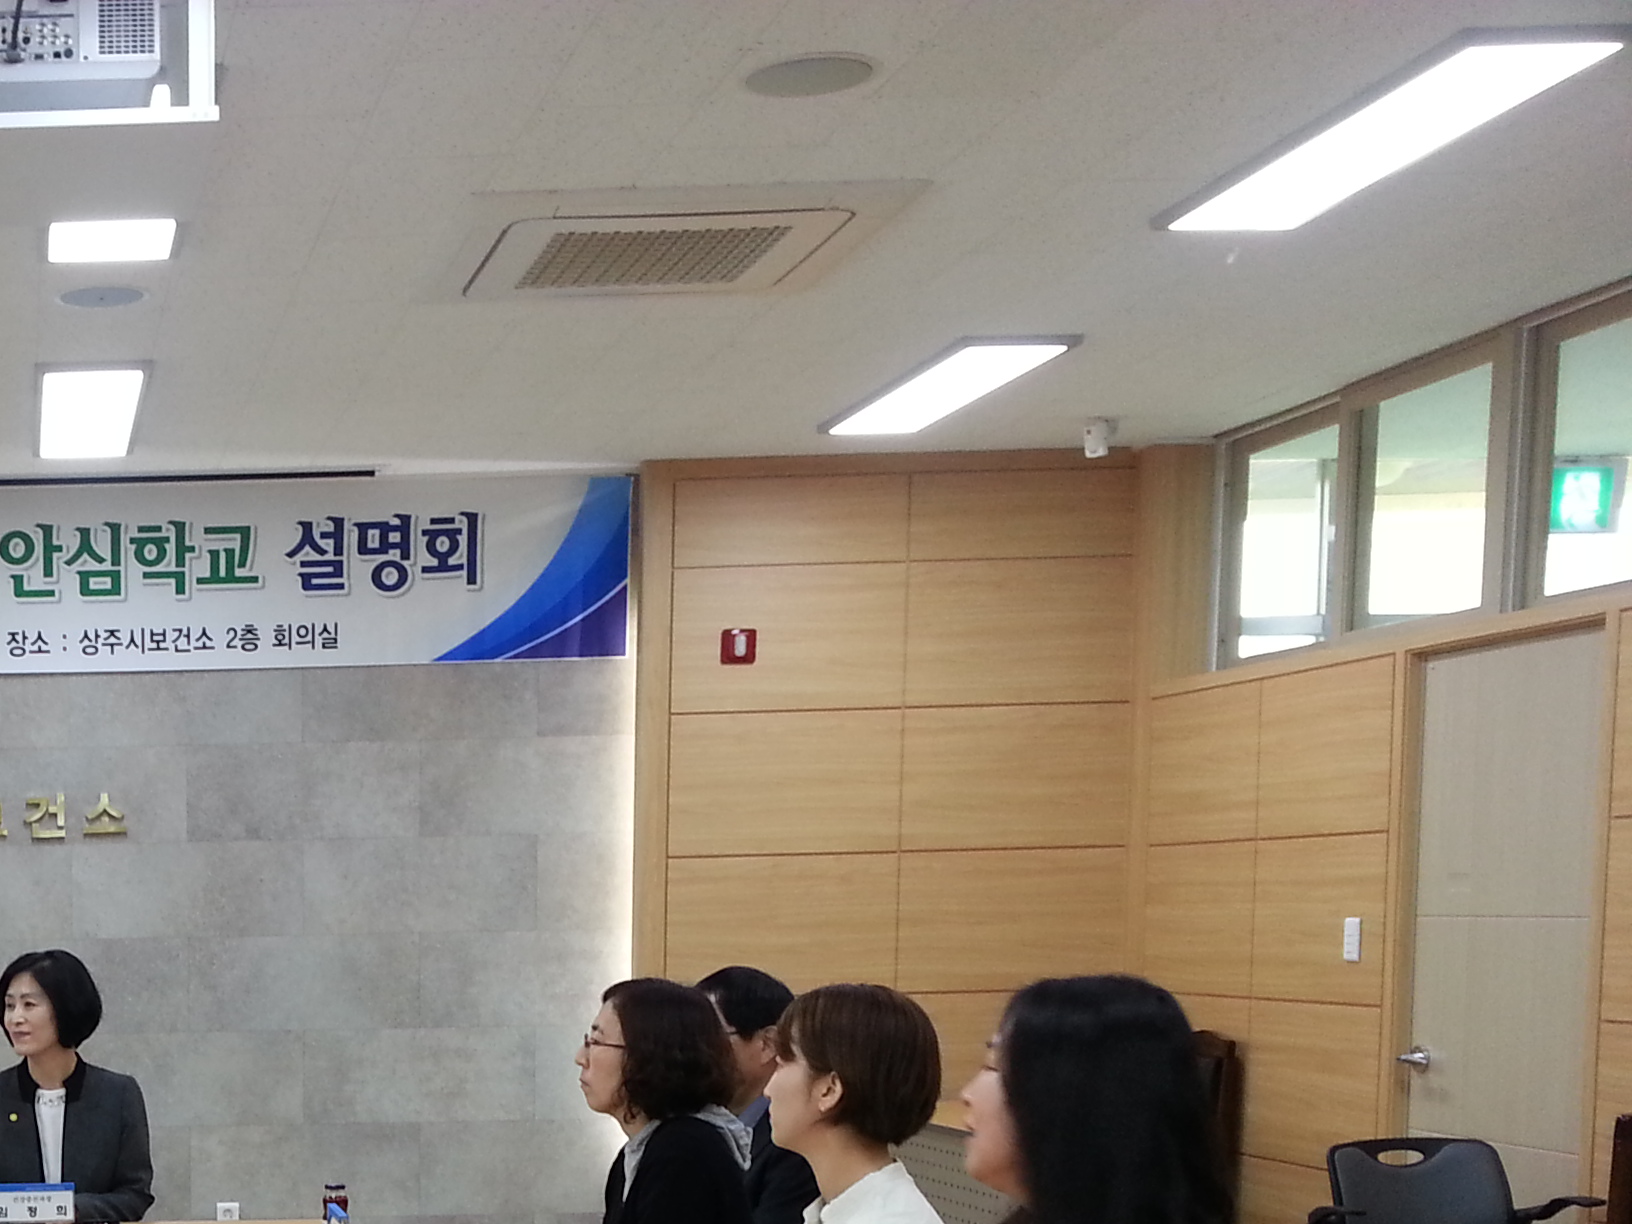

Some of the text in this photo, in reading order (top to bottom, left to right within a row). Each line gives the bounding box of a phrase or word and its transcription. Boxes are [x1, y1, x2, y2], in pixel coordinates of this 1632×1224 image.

[284, 511, 481, 593] 설명회
[5, 629, 51, 657] 장소
[78, 626, 216, 656] 상주시보건소
[225, 624, 261, 652] 2층
[272, 622, 340, 650] 회의실
